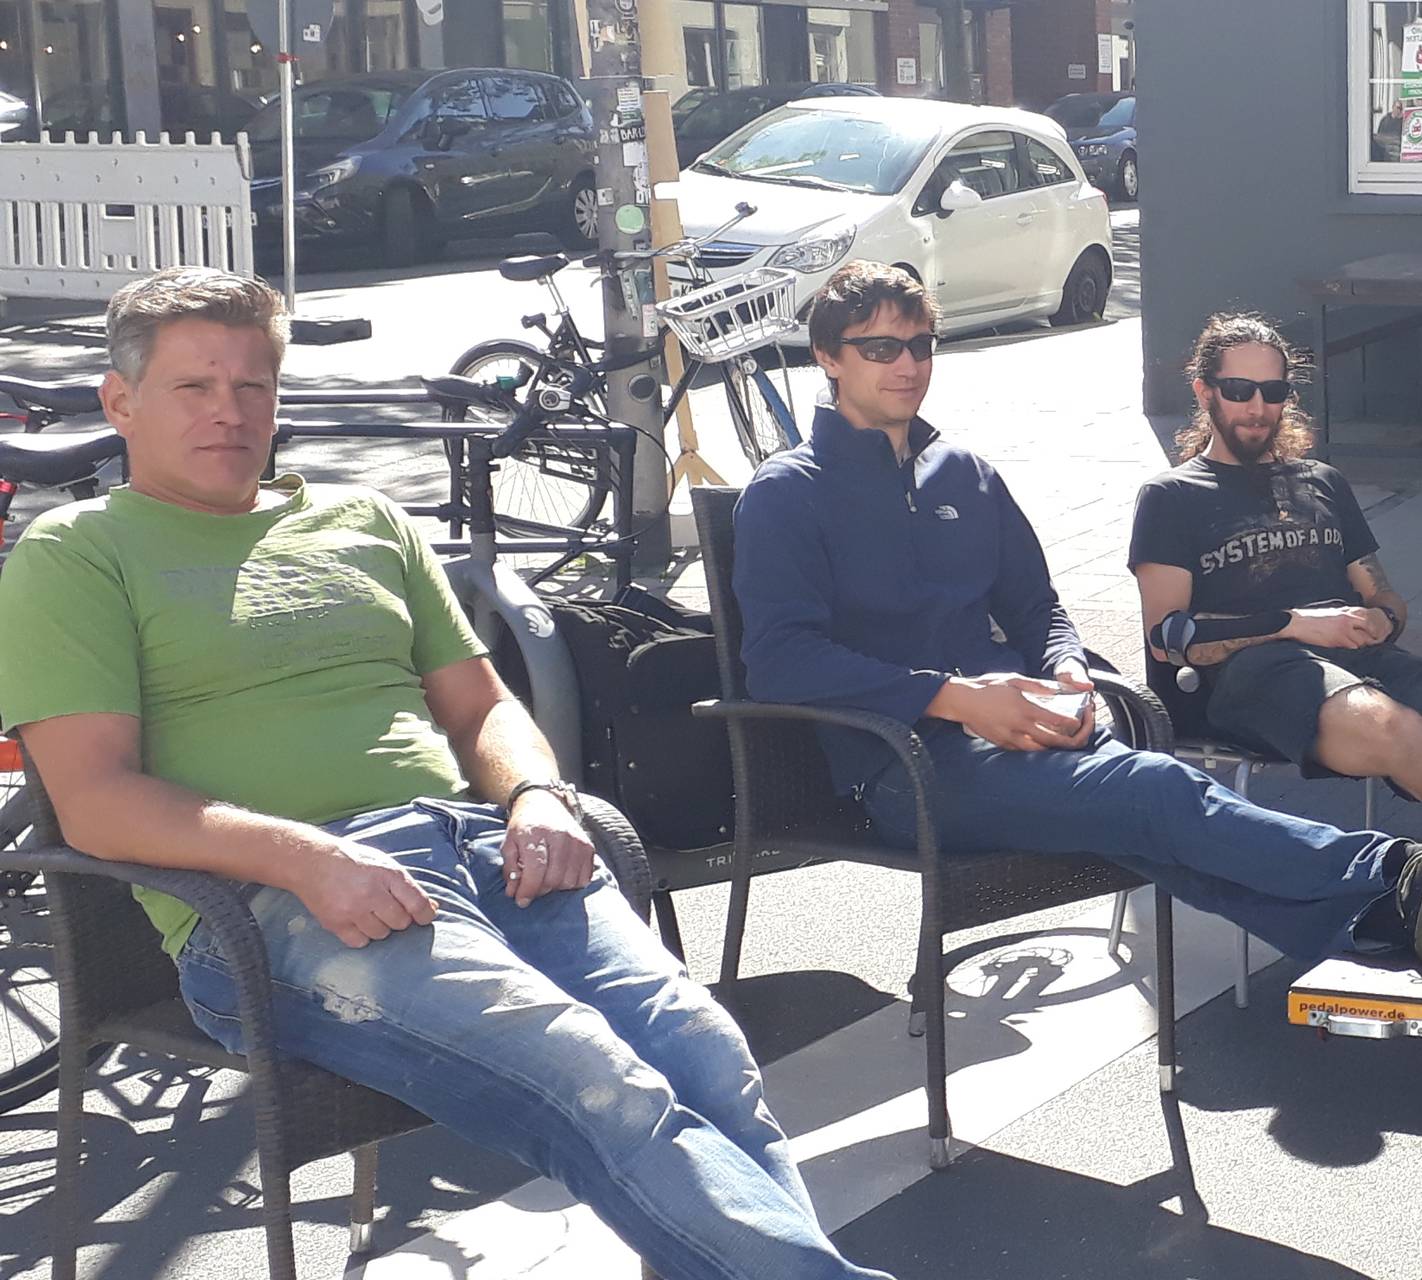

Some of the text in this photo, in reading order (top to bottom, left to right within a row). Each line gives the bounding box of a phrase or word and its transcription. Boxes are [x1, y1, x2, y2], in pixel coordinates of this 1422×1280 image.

[1199, 530, 1285, 576] SYSTEM
[1285, 528, 1307, 549] OF
[1310, 528, 1320, 545] A
[1299, 1002, 1406, 1020] pedalpower.de
